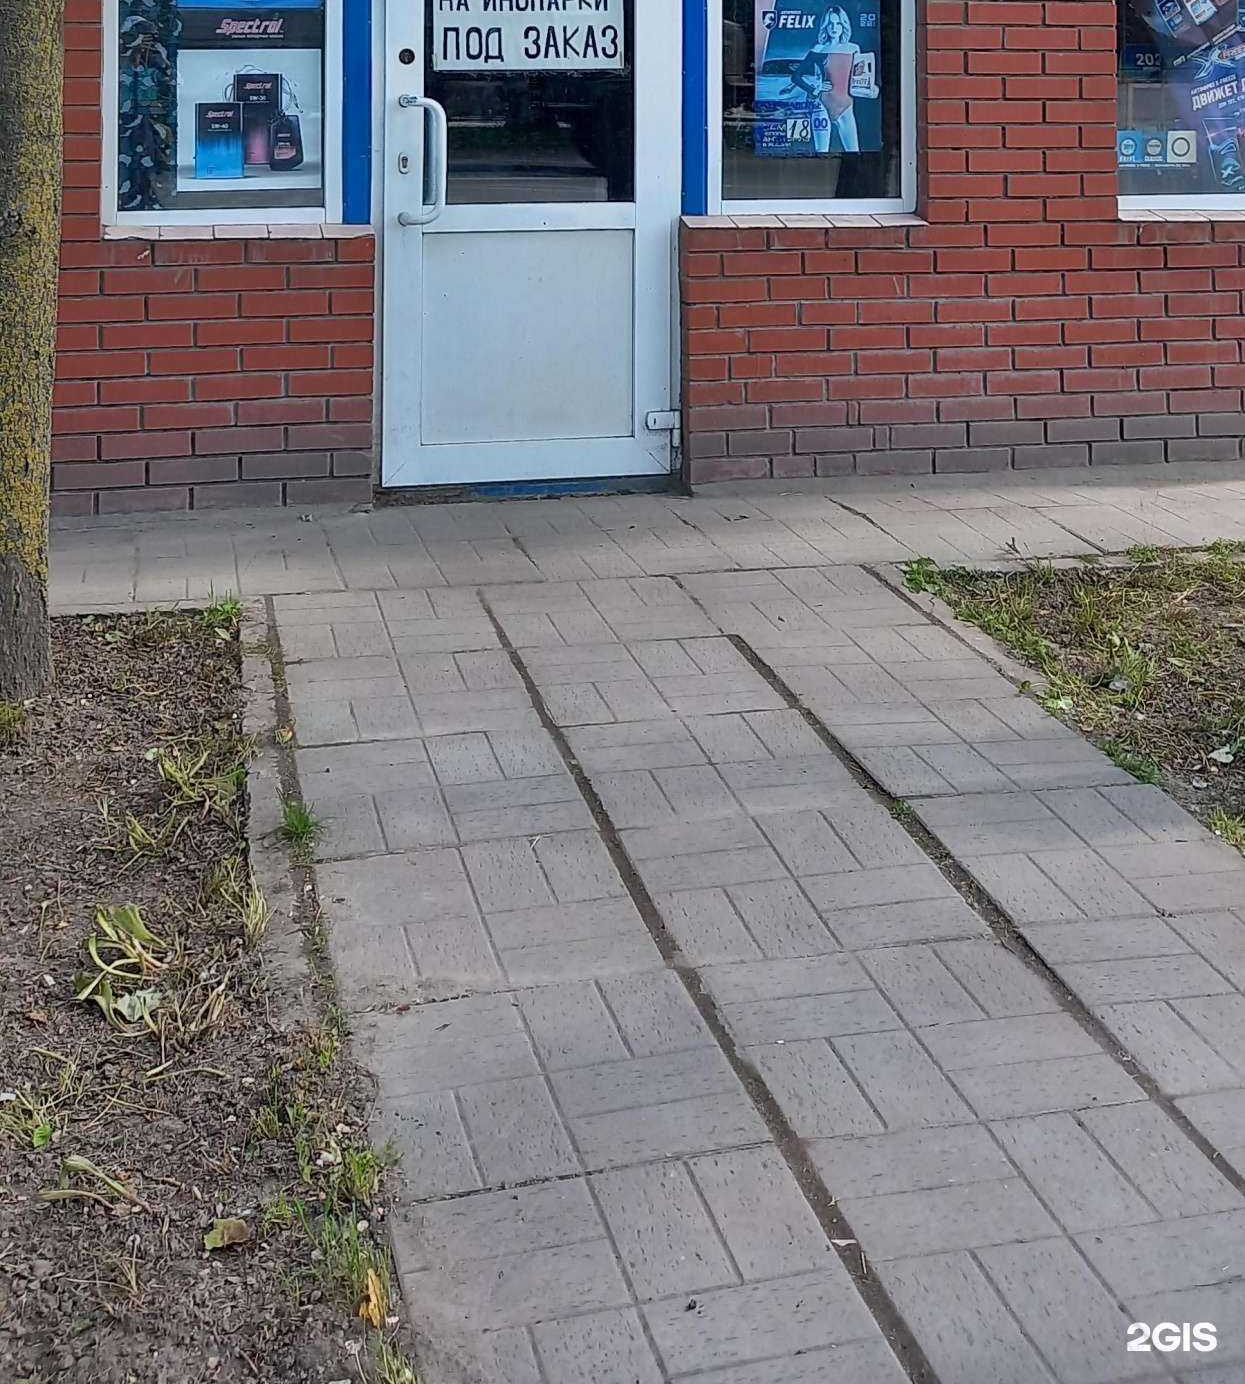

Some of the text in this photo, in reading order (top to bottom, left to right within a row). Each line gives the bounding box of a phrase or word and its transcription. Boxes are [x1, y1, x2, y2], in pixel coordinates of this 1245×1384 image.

[778, 15, 816, 29] FELIX
[443, 25, 618, 63] ПОД ЗАКАЗ
[1191, 80, 1238, 111] ДВИЖЕТ
